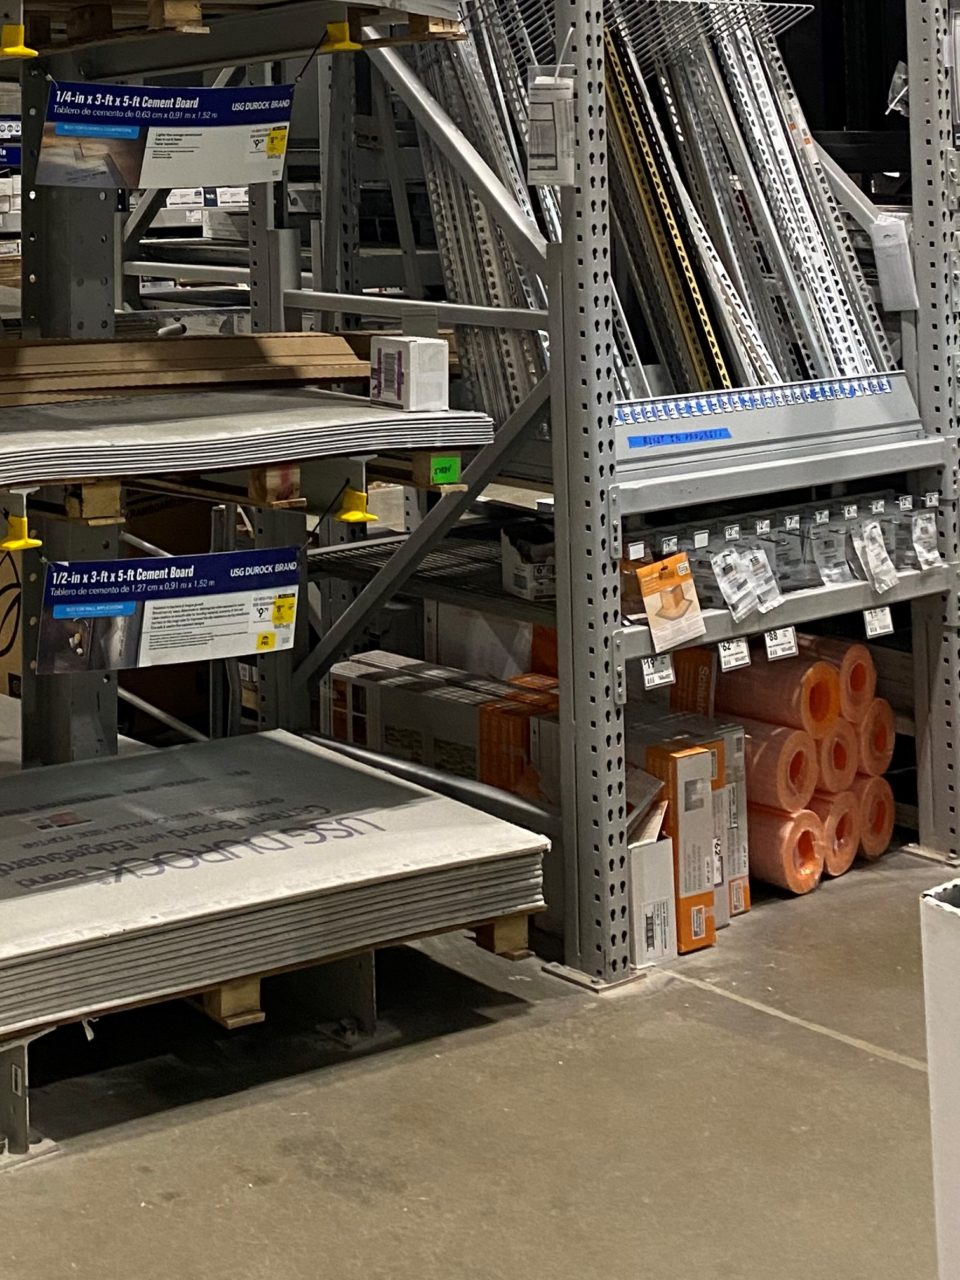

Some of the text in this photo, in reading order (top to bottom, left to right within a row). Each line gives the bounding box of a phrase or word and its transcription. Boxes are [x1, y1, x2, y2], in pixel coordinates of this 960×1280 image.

[56, 91, 85, 104] 1/4-in
[95, 94, 113, 106] 3-ft
[123, 96, 140, 107] 5-ft
[142, 97, 173, 108] Cement
[176, 97, 199, 108] Board
[232, 99, 290, 111] USG DUROCK BRAND
[54, 105, 80, 114] Tablero
[93, 110, 123, 118] cemento
[53, 572, 80, 584] 1/2-in
[90, 572, 108, 583] 3-ft
[117, 570, 134, 581] 5-ft
[137, 568, 168, 580] Cement
[170, 566, 194, 578] Board
[230, 562, 297, 577] USG DUROCK BRAND
[51, 587, 76, 596] Tablero
[248, 805, 331, 825] Cement
[130, 832, 169, 844] with
[168, 820, 246, 841] Board
[15, 816, 386, 889] USG DUROCK Brand
